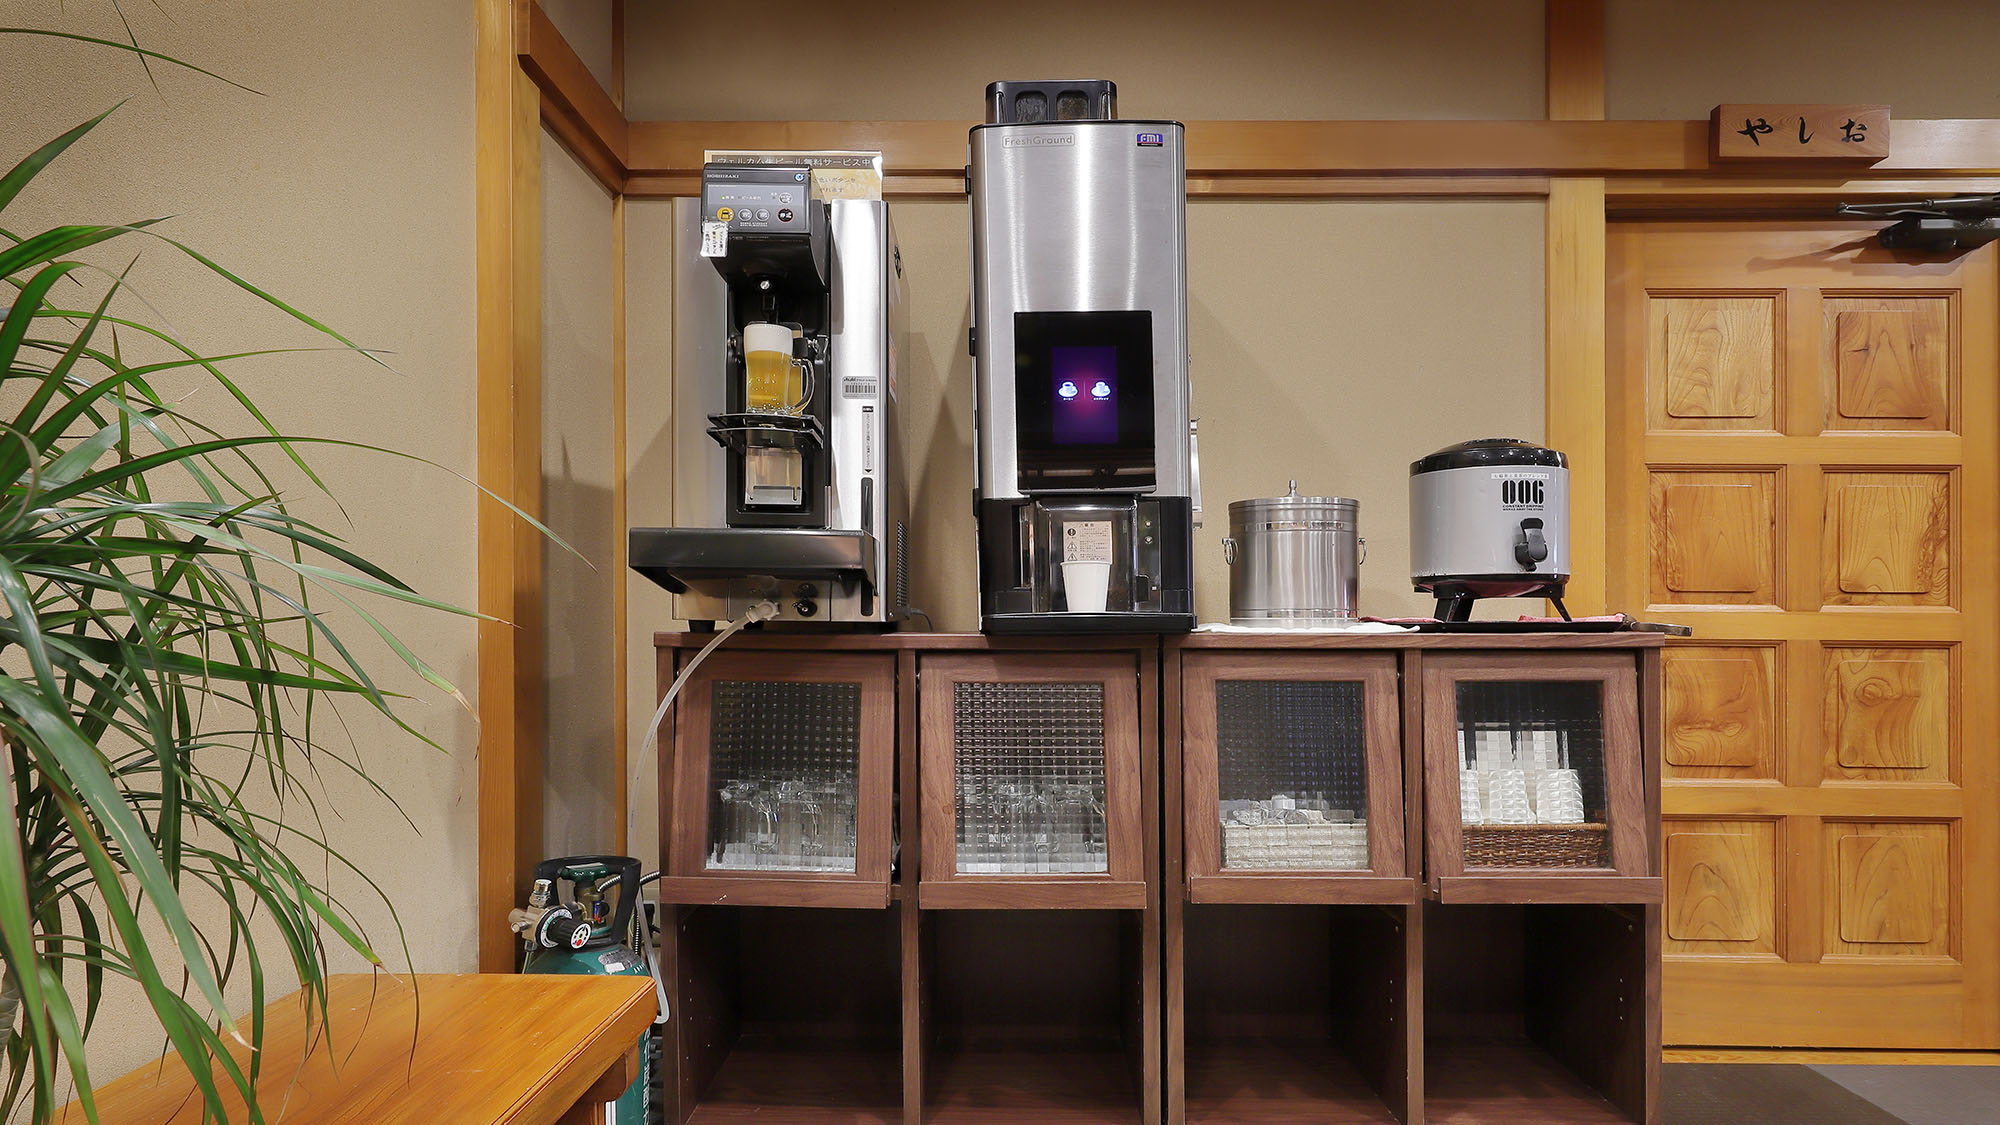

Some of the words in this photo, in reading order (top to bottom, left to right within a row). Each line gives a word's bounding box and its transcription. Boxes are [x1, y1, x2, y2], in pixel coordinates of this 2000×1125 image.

[1004, 135, 1073, 146] FreshGround
[1737, 116, 1868, 146] やしお
[1502, 480, 1544, 504] 006
